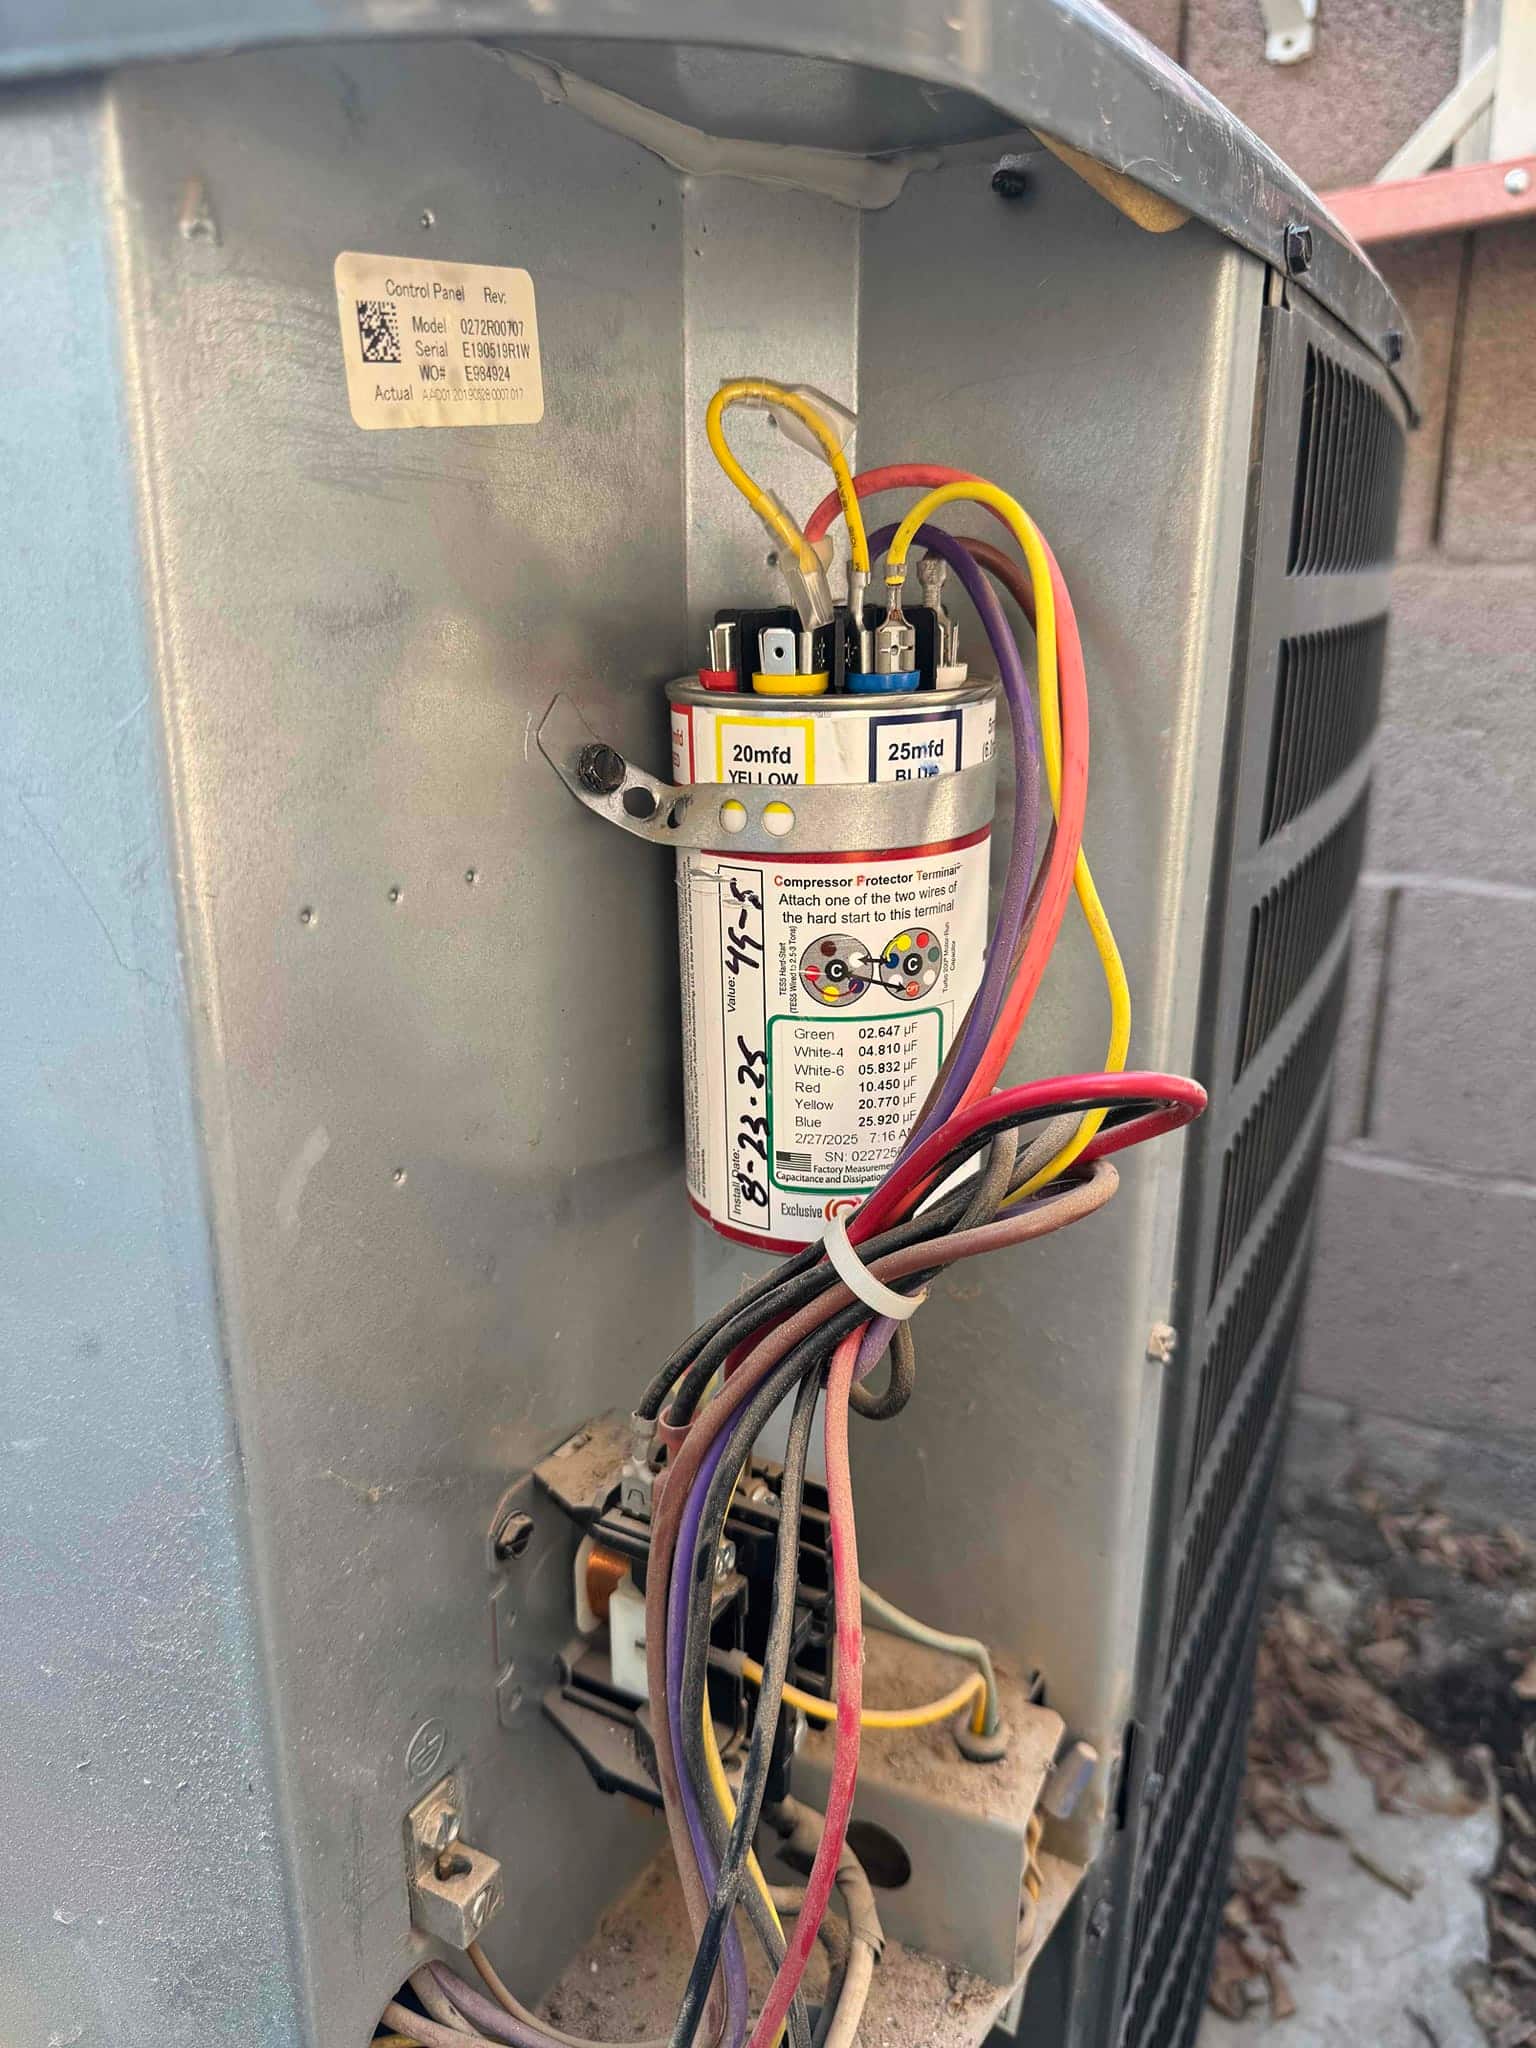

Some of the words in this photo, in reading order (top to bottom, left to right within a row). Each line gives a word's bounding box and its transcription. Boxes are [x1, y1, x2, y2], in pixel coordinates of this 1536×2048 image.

[385, 278, 430, 299] Control
[433, 282, 465, 302] Panel
[412, 316, 447, 335] Model
[415, 340, 449, 358] Serial
[375, 383, 414, 401] Actual
[733, 744, 792, 765] 20mfd
[887, 738, 944, 762] 25mfd
[774, 875, 853, 890] Compressor
[856, 872, 914, 887] Protector
[778, 892, 821, 907] Attach
[825, 896, 851, 907] one
[854, 892, 869, 906] of
[871, 891, 892, 904] the
[894, 890, 916, 903] two
[919, 886, 946, 900] wires
[948, 880, 958, 894] of
[782, 911, 803, 924] the
[807, 911, 837, 925] hard
[840, 911, 871, 924] start
[874, 909, 887, 922] to
[890, 907, 912, 920] this
[915, 899, 955, 918] terminal
[727, 976, 736, 1013] Value:
[794, 1028, 835, 1040] Green
[858, 1025, 901, 1039] 02.647
[794, 1046, 844, 1058] White-4
[858, 1042, 901, 1057] 04.810
[794, 1064, 845, 1077] White-6
[858, 1061, 901, 1075] 05.832
[795, 1082, 821, 1094] Red
[858, 1078, 900, 1092] 10.450
[794, 1098, 834, 1111] Yellow
[858, 1095, 900, 1110] 20.770
[795, 1115, 822, 1128] Blue
[858, 1113, 900, 1127] 25.920
[795, 1133, 858, 1145] 2/27/2025
[869, 1130, 896, 1144] 7:16
[824, 1151, 848, 1163] SN:
[776, 1172, 828, 1184] Capacitance
[829, 1174, 841, 1184] and
[813, 1164, 843, 1175] Factory
[733, 1181, 742, 1215] Install
[781, 1202, 823, 1219] Exclusive
